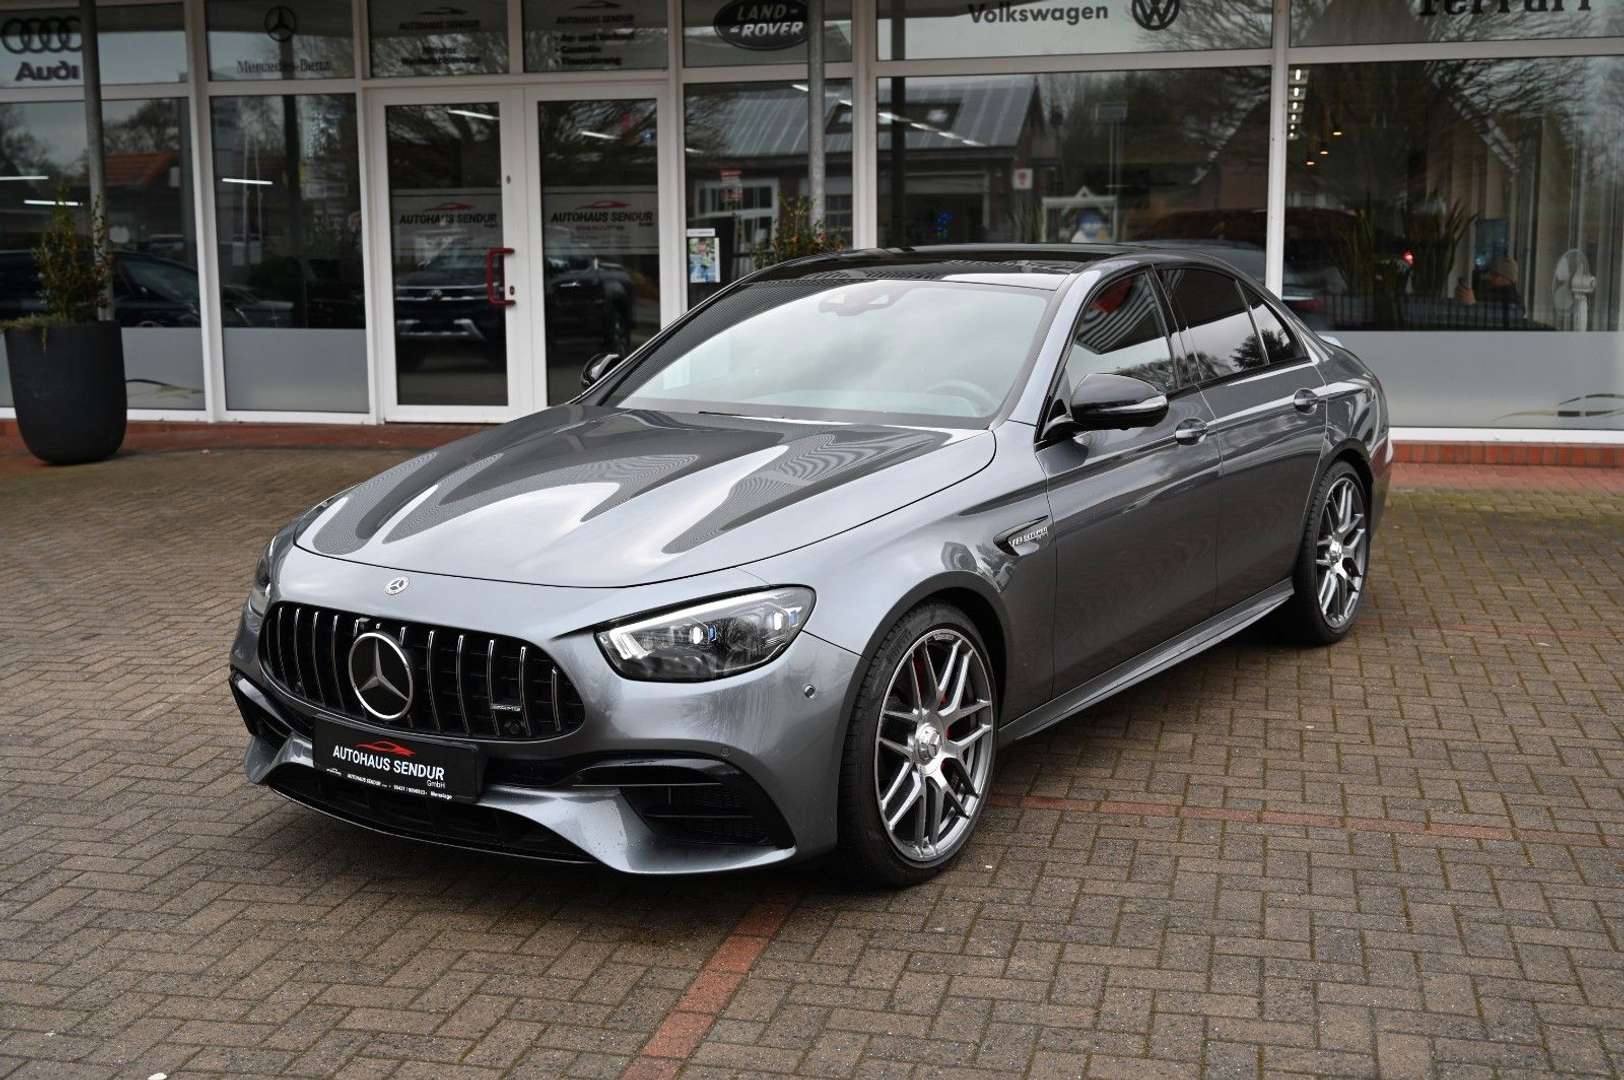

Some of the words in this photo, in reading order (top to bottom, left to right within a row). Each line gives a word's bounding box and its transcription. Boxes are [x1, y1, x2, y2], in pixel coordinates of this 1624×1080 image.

[969, 5, 1109, 26] Volkswagen
[741, 22, 804, 38] ROVER
[14, 60, 80, 82] Audi
[399, 213, 454, 225] AUTOHAUS
[456, 212, 497, 224] SENDUR
[551, 212, 608, 224] AUTOHAUS
[611, 211, 654, 222] SENDUR
[332, 745, 392, 772] AUTOHAUS
[393, 760, 445, 781] SENDUR
[427, 779, 446, 790] GmbH
